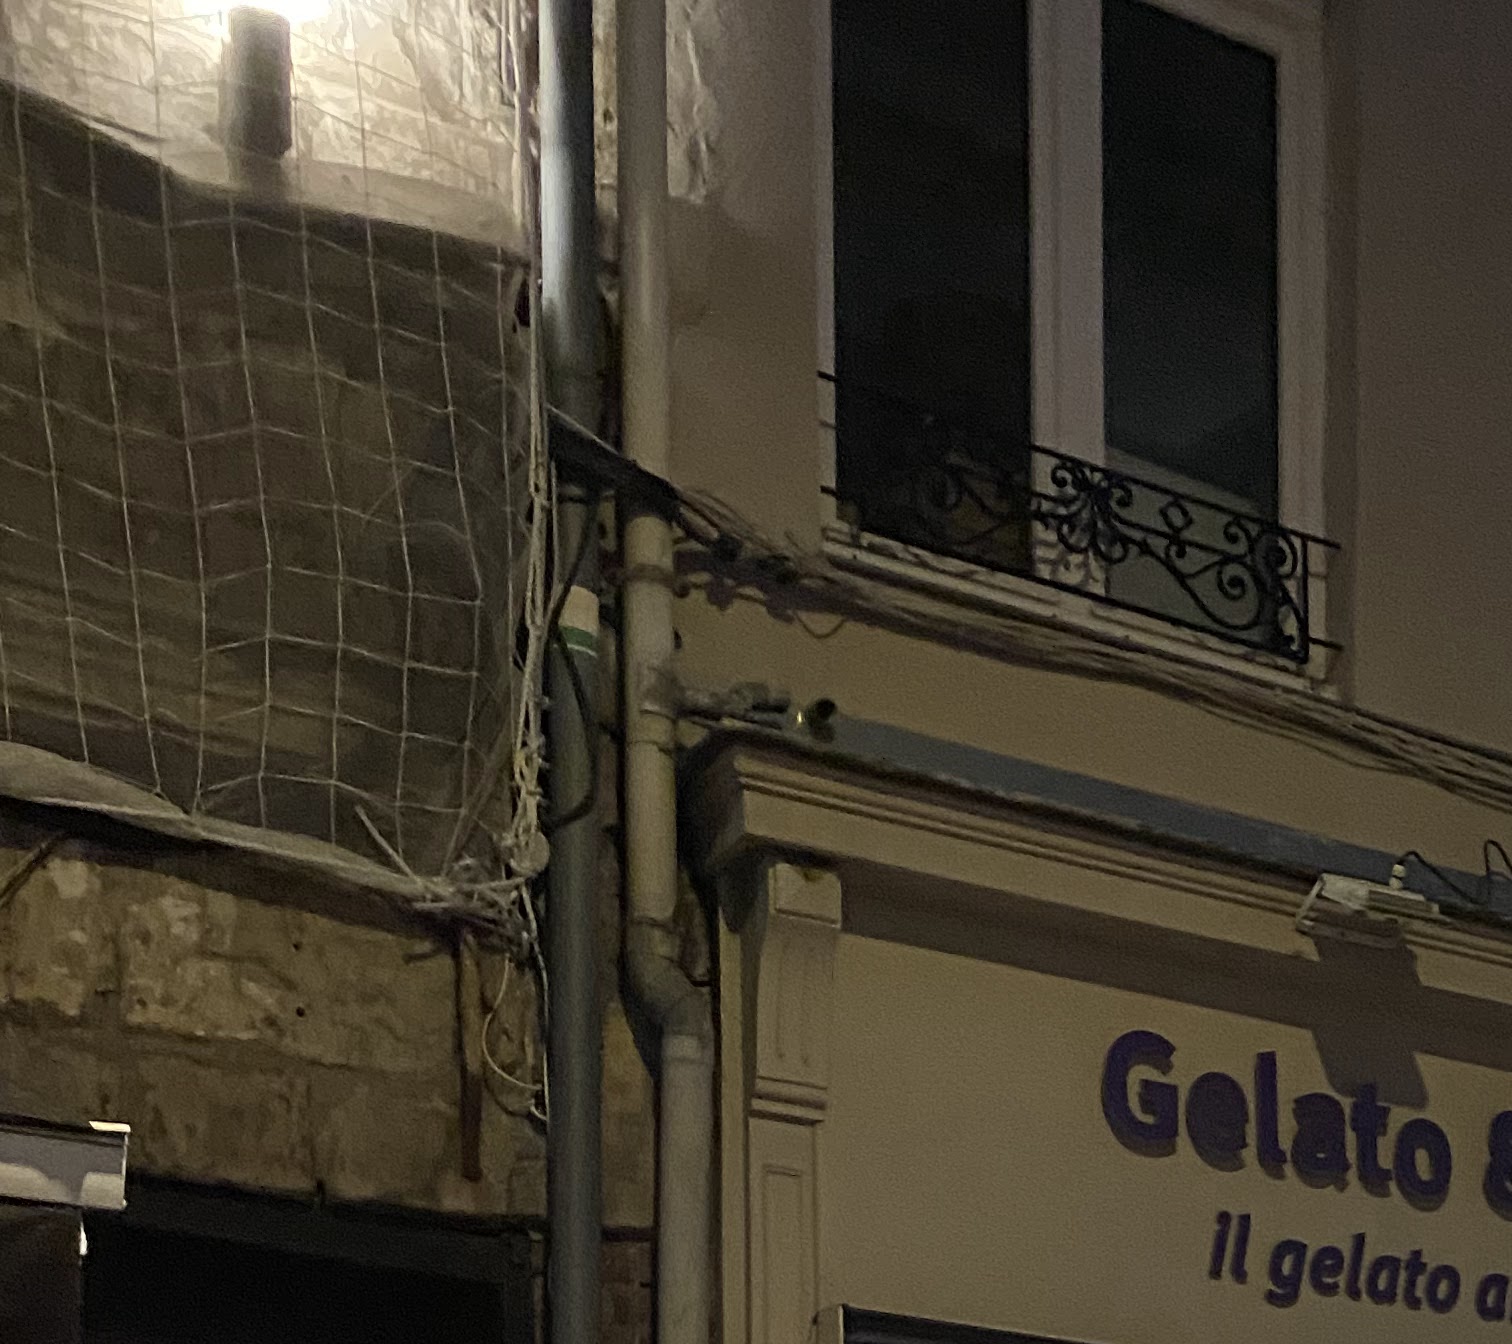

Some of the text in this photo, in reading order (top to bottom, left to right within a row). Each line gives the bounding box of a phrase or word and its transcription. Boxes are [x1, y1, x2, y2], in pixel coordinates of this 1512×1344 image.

[1101, 1029, 1453, 1208] Gelato
[1208, 1211, 1252, 1284] il
[1264, 1232, 1461, 1312] gelato
